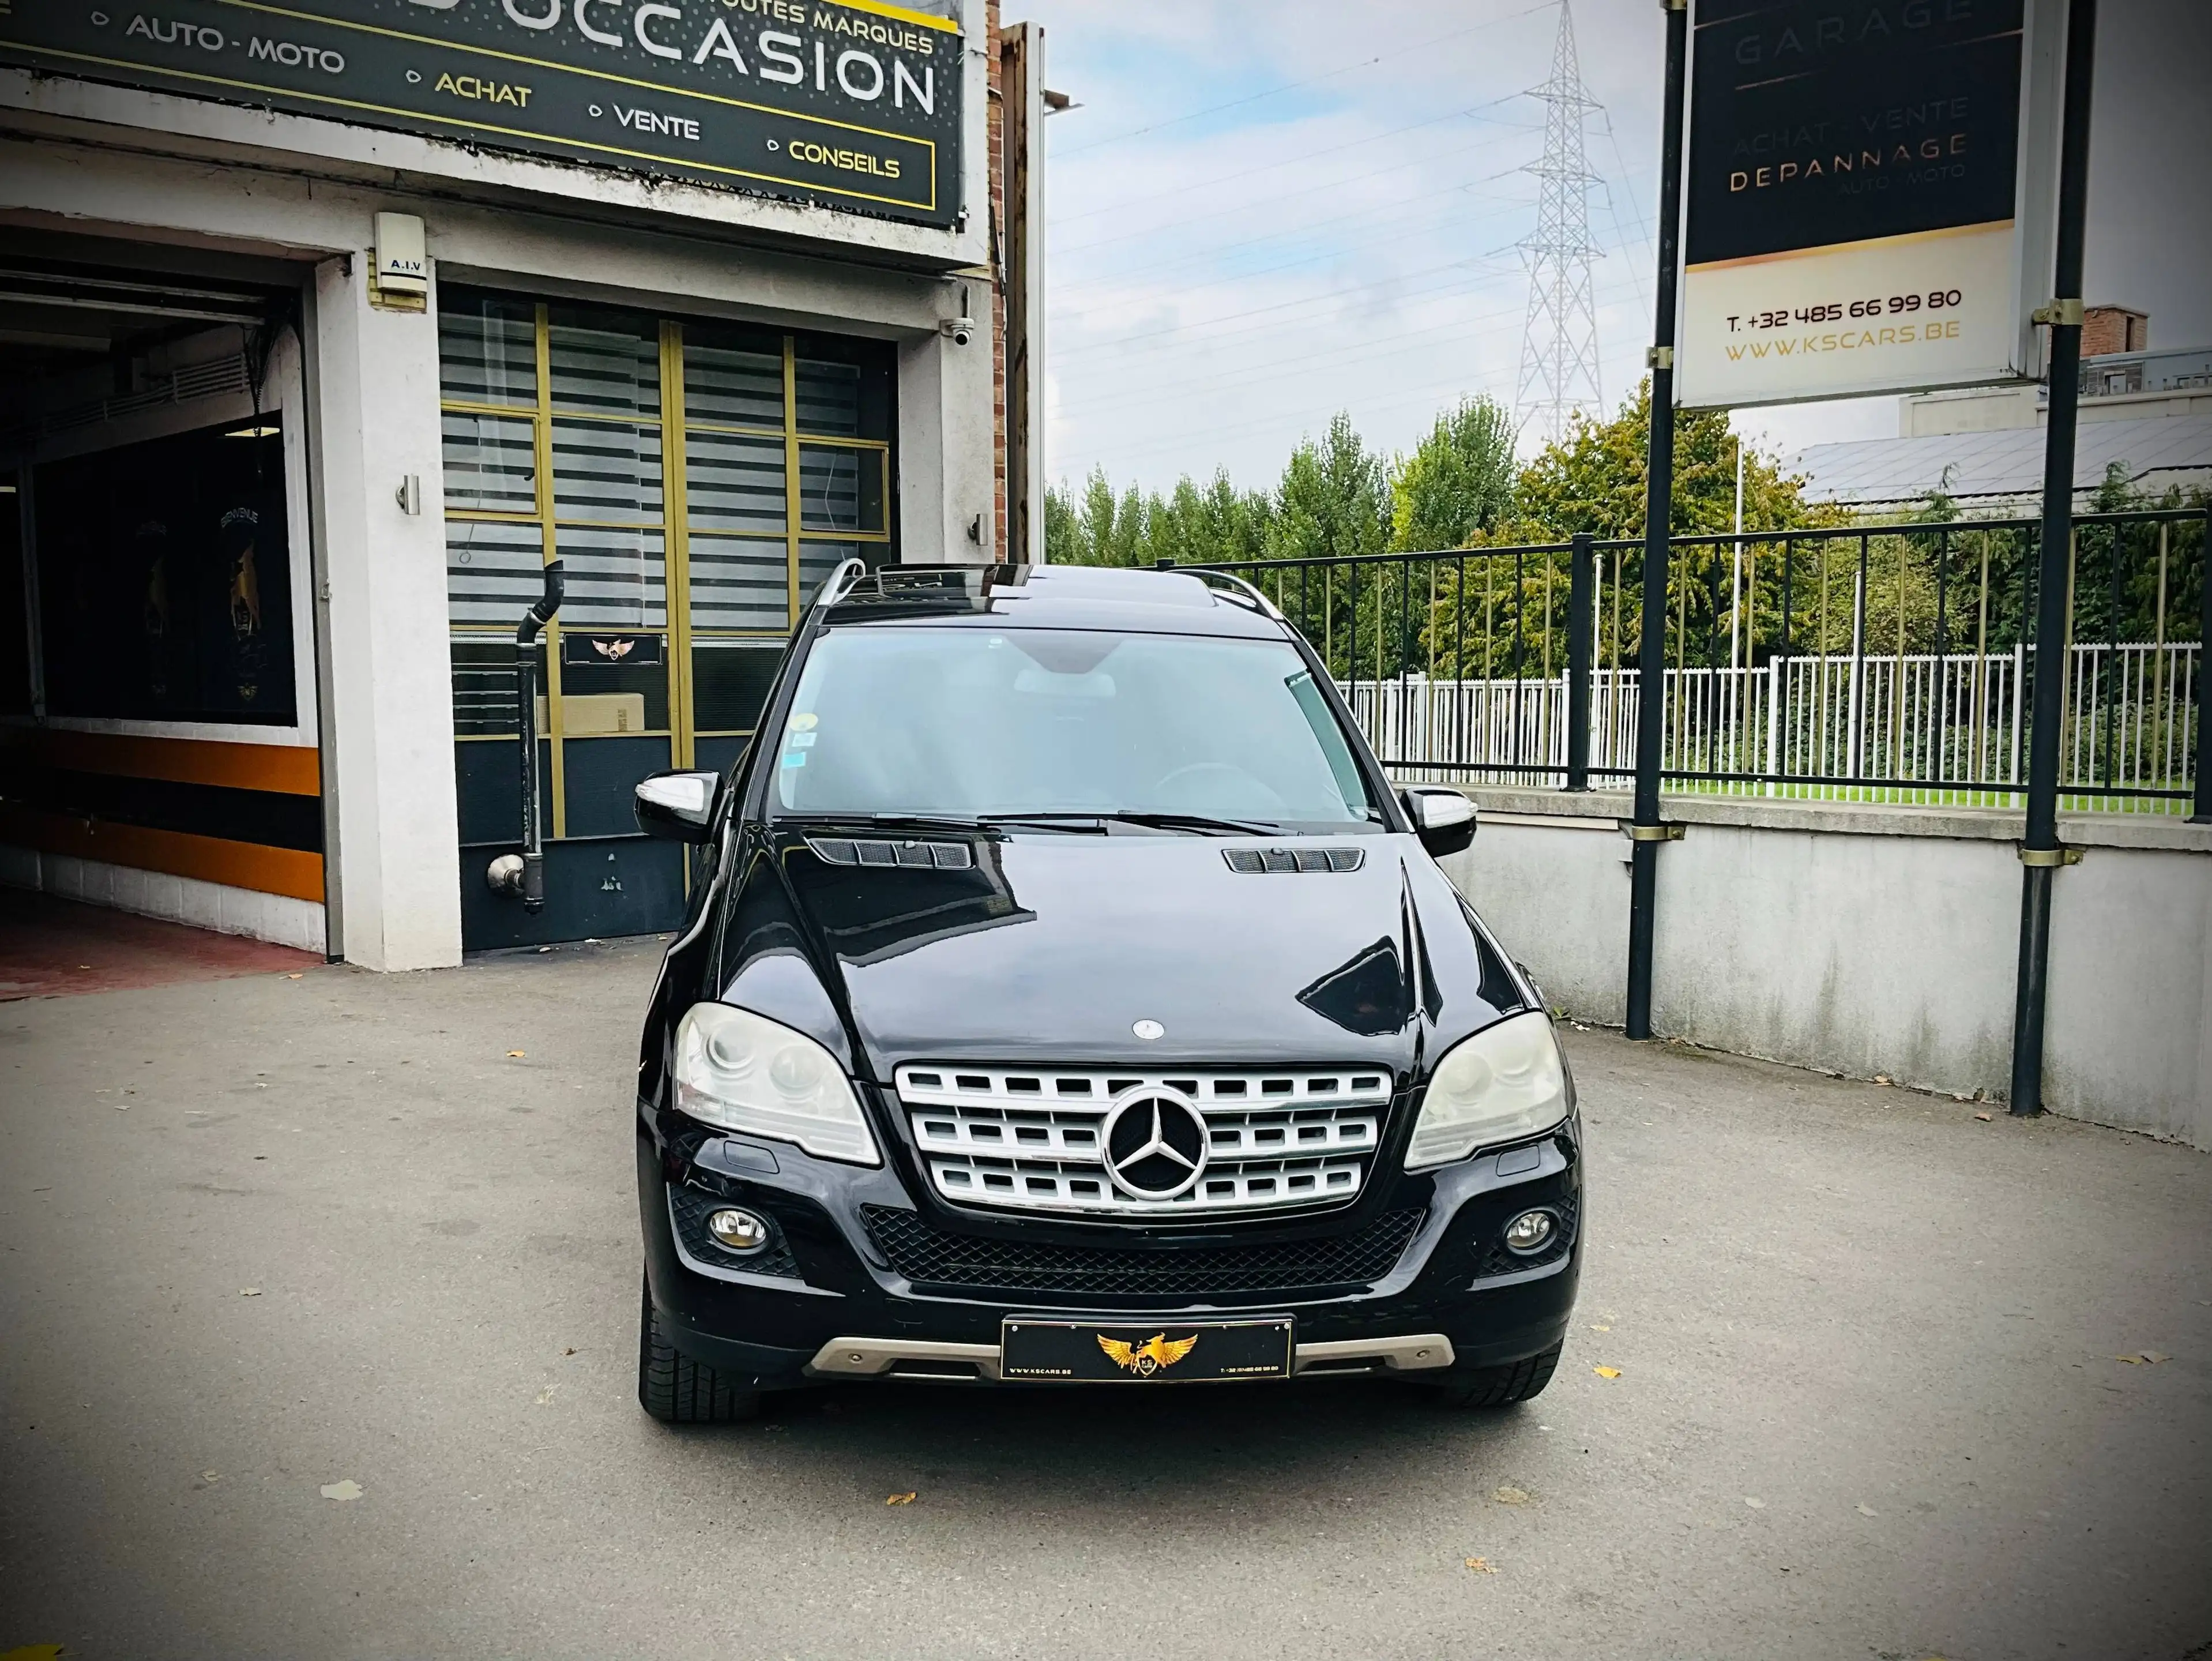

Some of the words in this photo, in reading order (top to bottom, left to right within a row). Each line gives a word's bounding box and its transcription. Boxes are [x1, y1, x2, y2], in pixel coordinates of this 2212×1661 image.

[125, 14, 224, 51] AUTO
[247, 36, 345, 73] MOTO
[710, 0, 805, 24] UTES
[813, 10, 932, 54] MARQUES
[1736, 0, 1972, 65] GARAGE
[408, 0, 934, 115] OCCASION
[434, 73, 532, 107] ACHAT
[612, 102, 700, 141] VENTE
[1733, 122, 1830, 156] ACHAT
[1860, 97, 1969, 133] VENTE
[788, 141, 900, 179] CONSEILS
[1729, 134, 1967, 192] DEPANNAGE
[391, 260, 420, 270] A.I.V
[1726, 316, 1741, 332] T.
[1748, 310, 1788, 329] +32
[1795, 303, 1842, 324] 485
[1849, 299, 1881, 317] 66
[1889, 295, 1921, 313] 99
[1928, 290, 1961, 309] 80
[1725, 321, 1960, 362] WWW.KSCARS.BE
